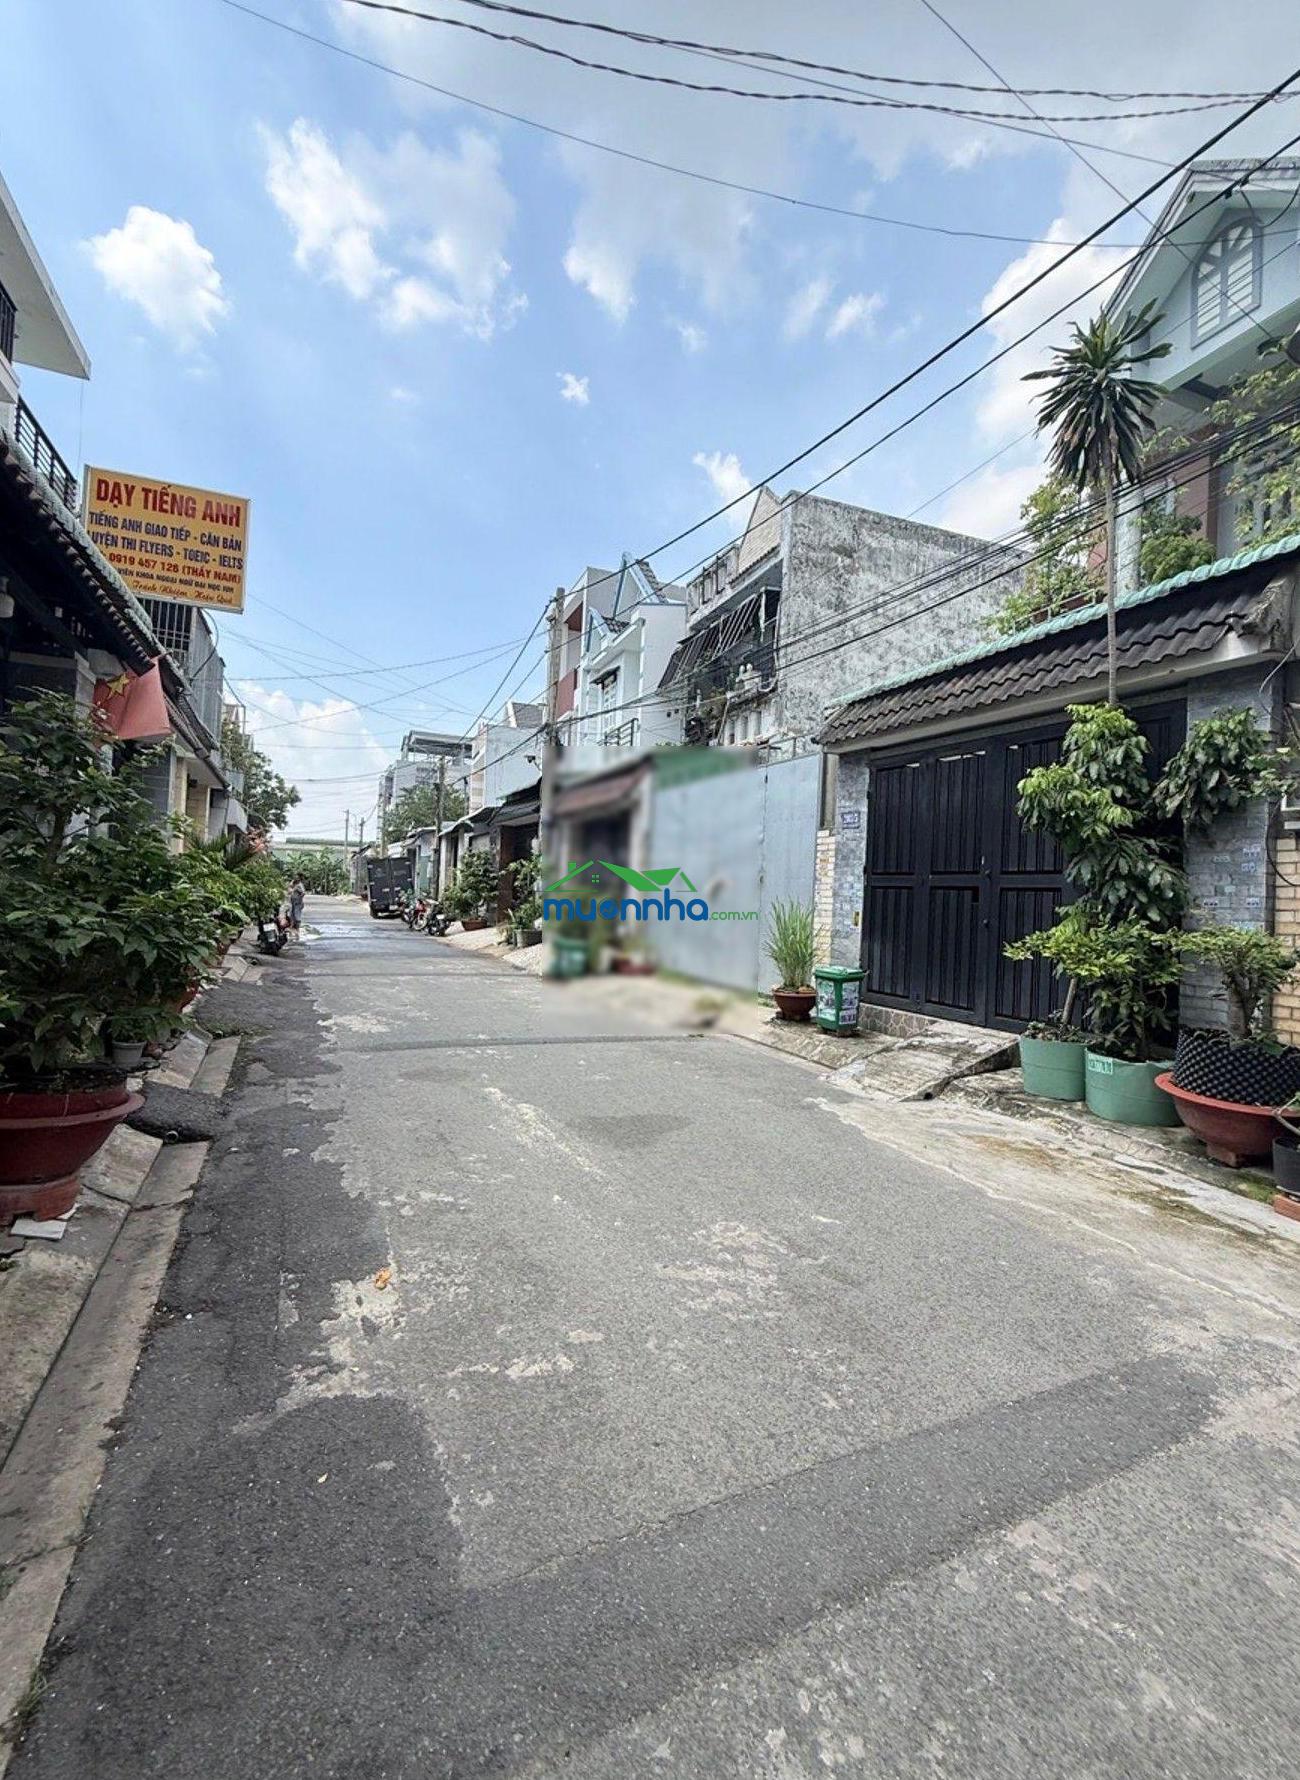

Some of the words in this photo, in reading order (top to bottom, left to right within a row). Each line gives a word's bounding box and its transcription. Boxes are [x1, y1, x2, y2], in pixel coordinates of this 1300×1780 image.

[96, 478, 136, 508] DẠY
[142, 484, 197, 519] TIẾNG
[202, 499, 241, 528] ANH
[121, 518, 143, 533] ANH
[144, 522, 169, 538] GIAO
[109, 552, 136, 566] 0919
[121, 536, 137, 551] THI
[140, 540, 174, 558] FLYERS
[183, 548, 210, 564] TOEIC
[219, 554, 244, 571] IELTS
